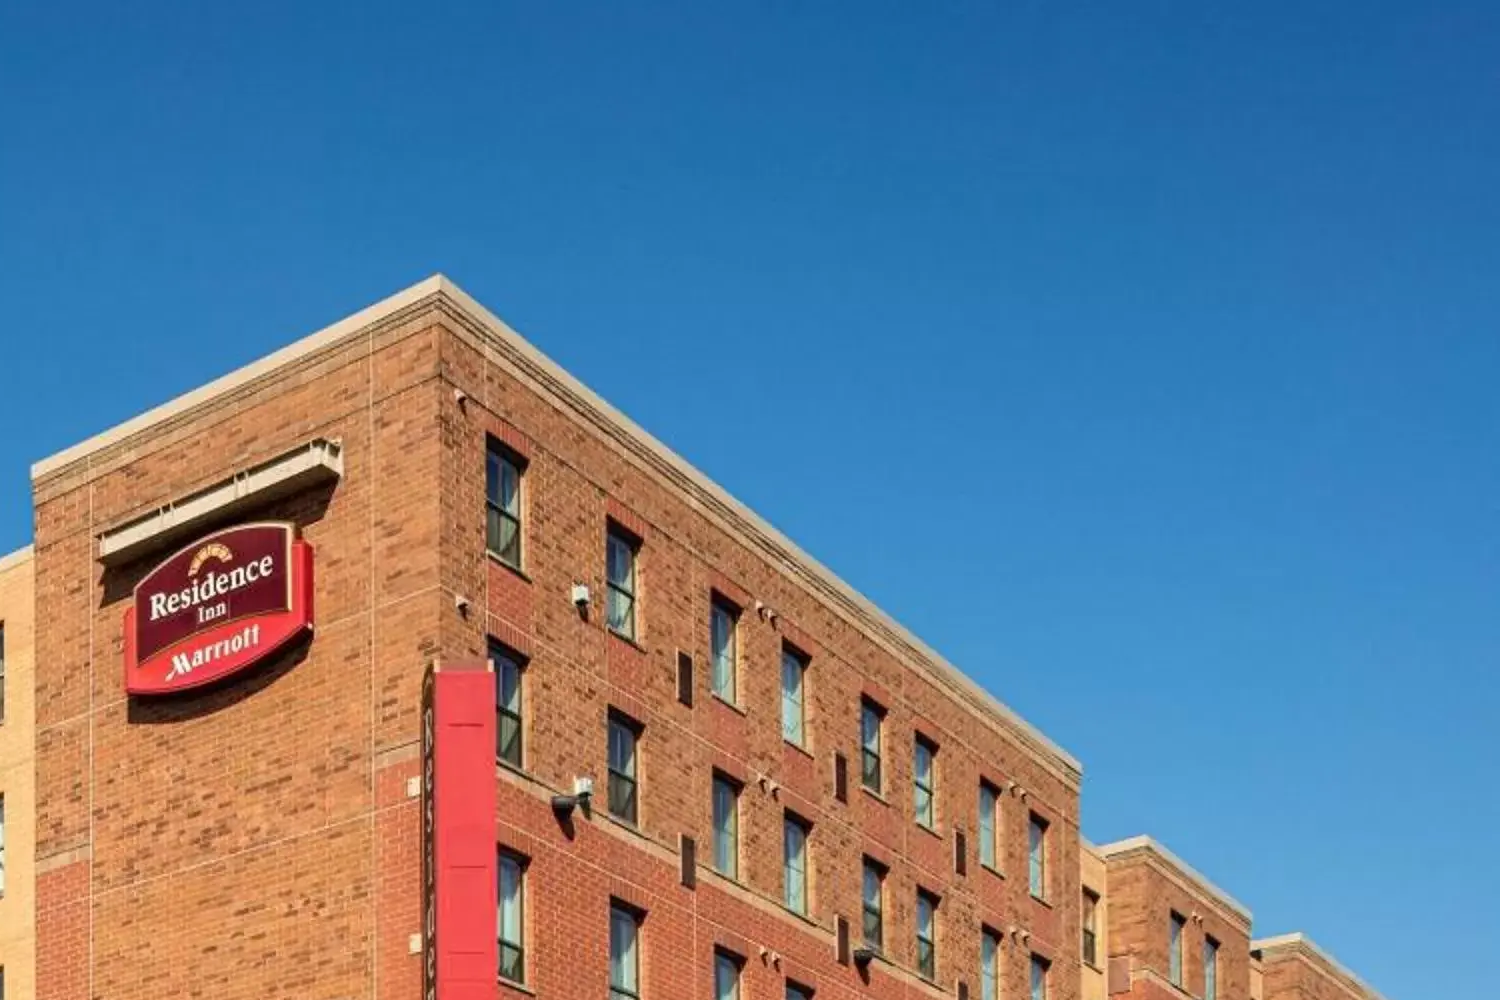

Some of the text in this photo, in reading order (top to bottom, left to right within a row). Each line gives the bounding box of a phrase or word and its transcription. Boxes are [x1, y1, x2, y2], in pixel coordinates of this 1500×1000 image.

[149, 555, 274, 621] Residence
[197, 602, 227, 623] Inn
[165, 624, 260, 681] Marriott
